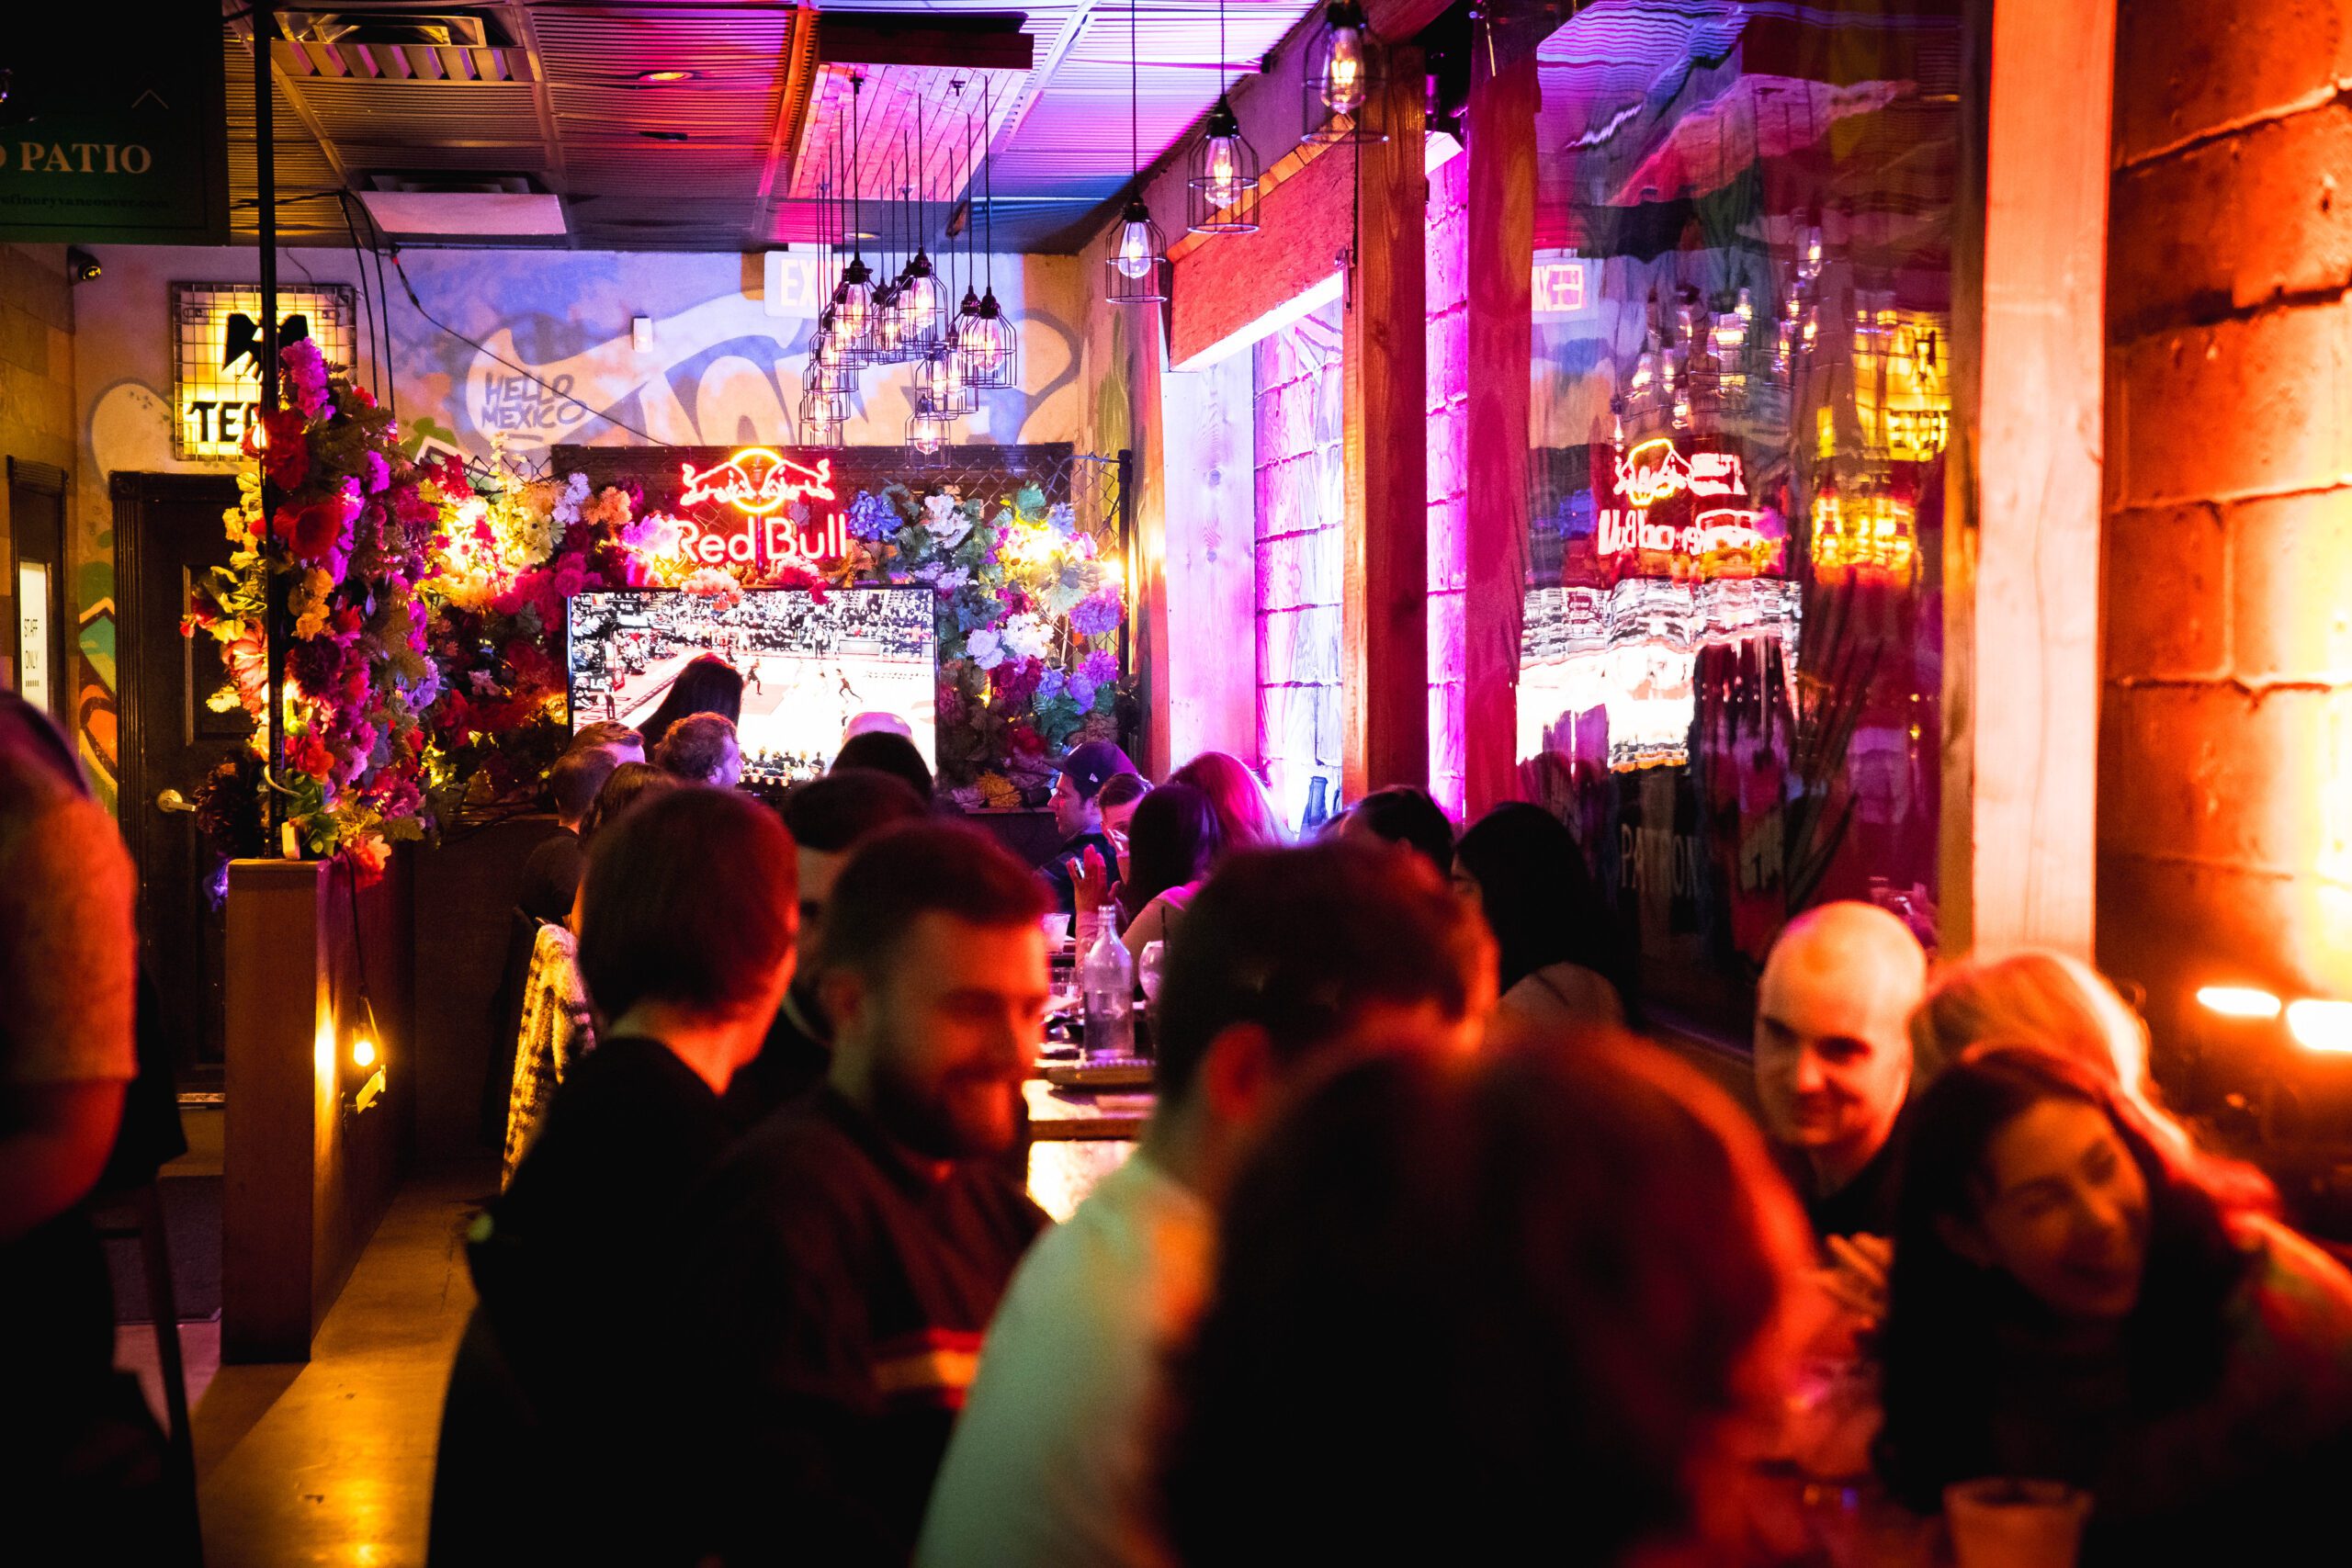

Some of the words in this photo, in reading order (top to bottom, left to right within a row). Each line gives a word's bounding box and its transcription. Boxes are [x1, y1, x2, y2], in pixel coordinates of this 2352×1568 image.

[19, 142, 152, 174] PATIO
[485, 371, 574, 405] HELLO
[481, 400, 605, 429] MEXICO
[673, 515, 756, 563] Red
[764, 513, 847, 560] Bull
[590, 678, 605, 689] LG
